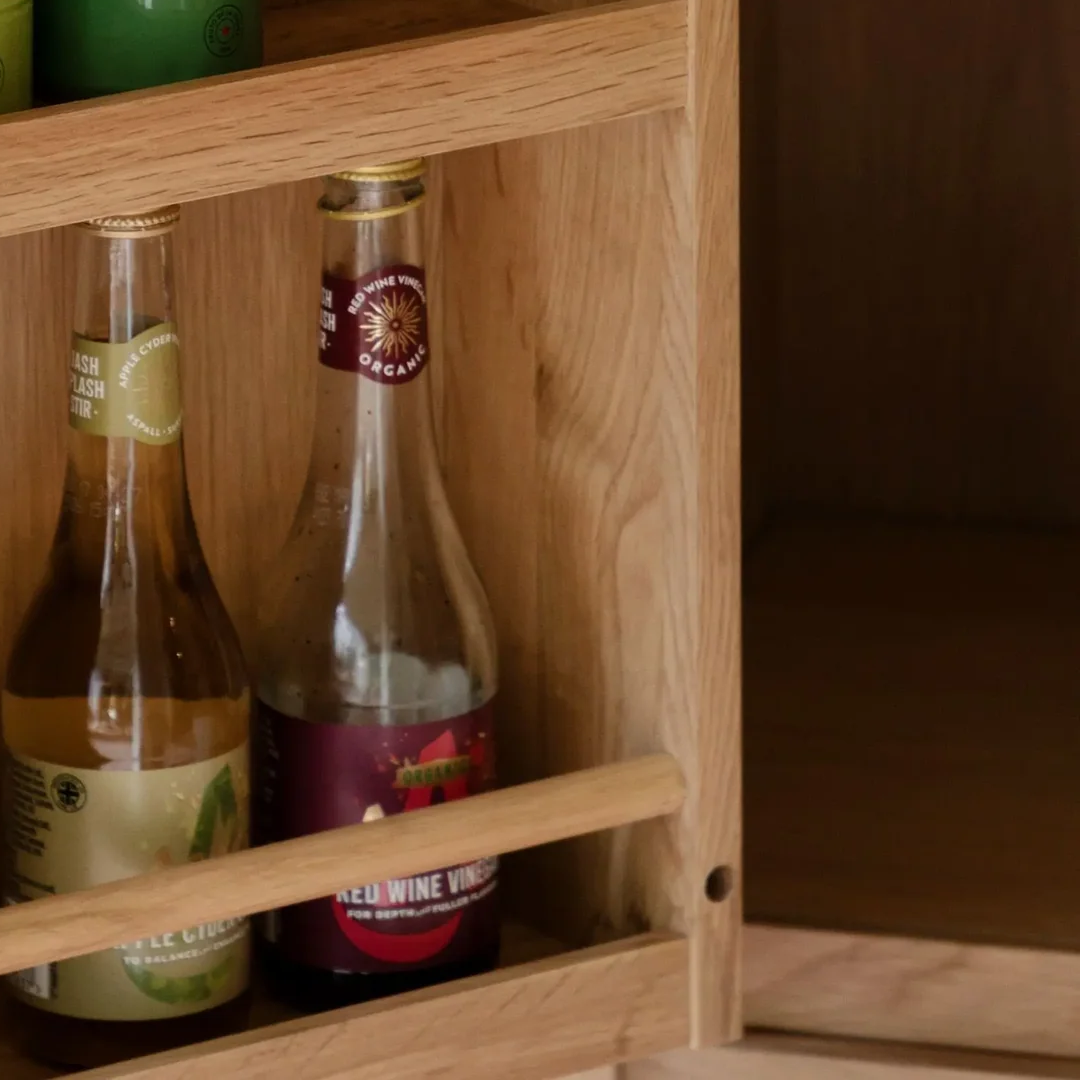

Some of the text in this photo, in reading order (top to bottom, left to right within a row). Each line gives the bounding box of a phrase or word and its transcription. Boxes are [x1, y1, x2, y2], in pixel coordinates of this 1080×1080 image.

[347, 292, 365, 315] RED
[363, 275, 395, 294] WINE
[119, 333, 171, 389] APPLE CYDER
[359, 344, 426, 377] ORGANIC
[387, 873, 444, 903] WINE
[123, 956, 141, 966] TO
